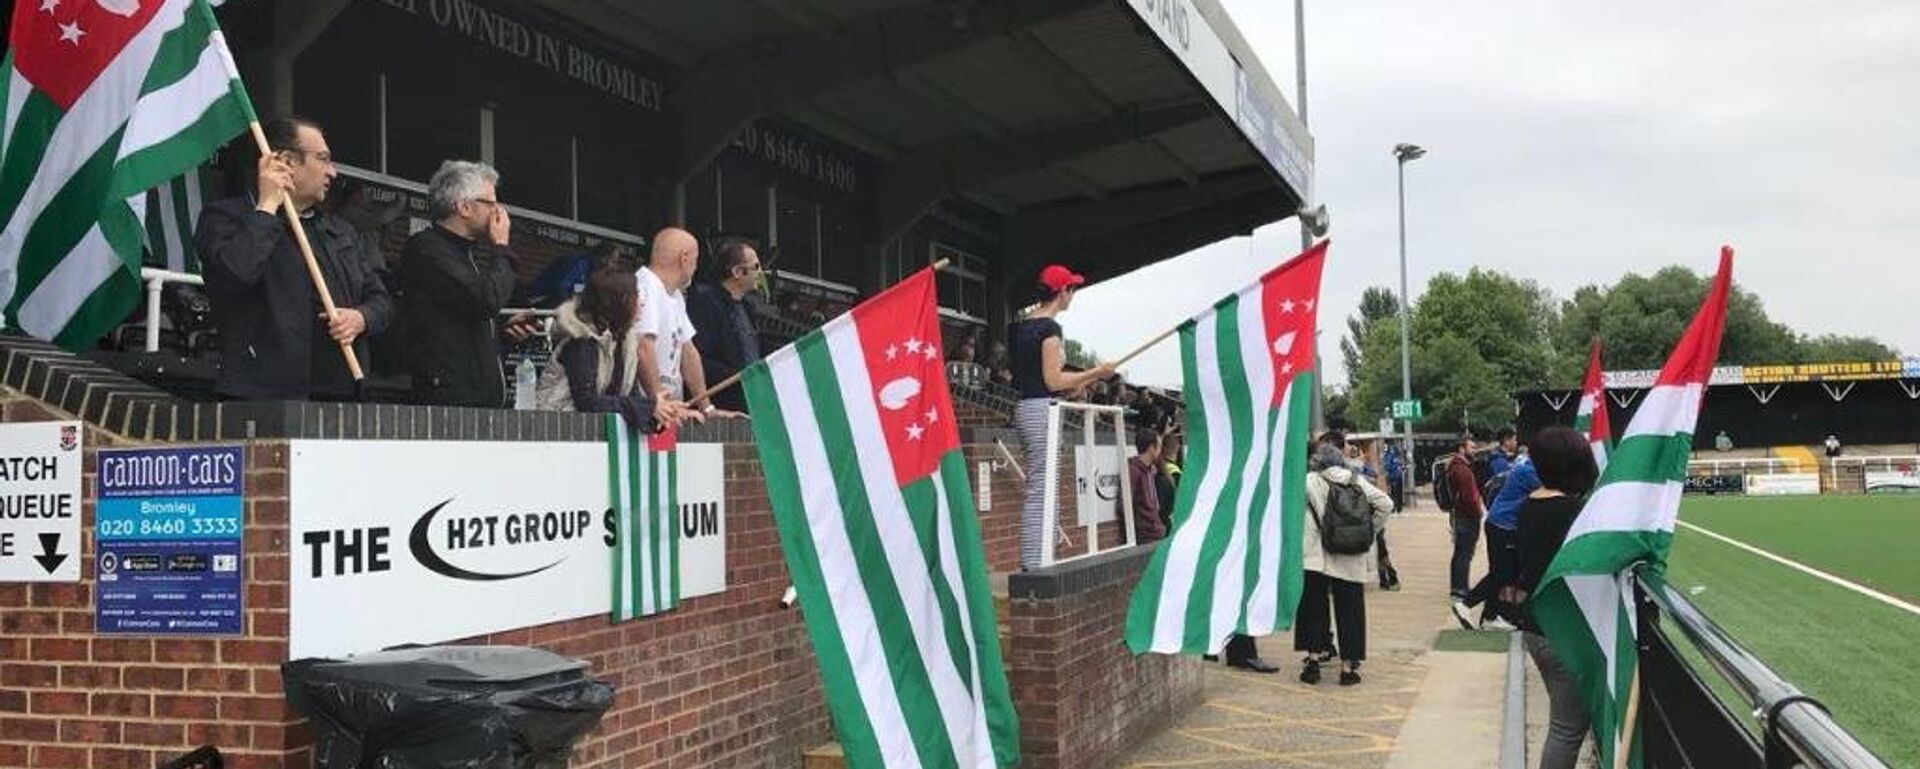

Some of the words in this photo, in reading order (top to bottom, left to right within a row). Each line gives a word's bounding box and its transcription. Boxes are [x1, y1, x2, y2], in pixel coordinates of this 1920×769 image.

[535, 28, 561, 71] IN
[567, 45, 662, 111] BROMLEY
[1744, 365, 1794, 377] ACTION
[1393, 401, 1414, 417] EXIT
[141, 501, 196, 516] Bromley
[101, 519, 134, 535] 020
[140, 519, 185, 534] 8460
[192, 518, 238, 534] 3333
[303, 527, 391, 578] THE
[446, 514, 501, 551] H2T
[505, 509, 592, 545] GROUP
